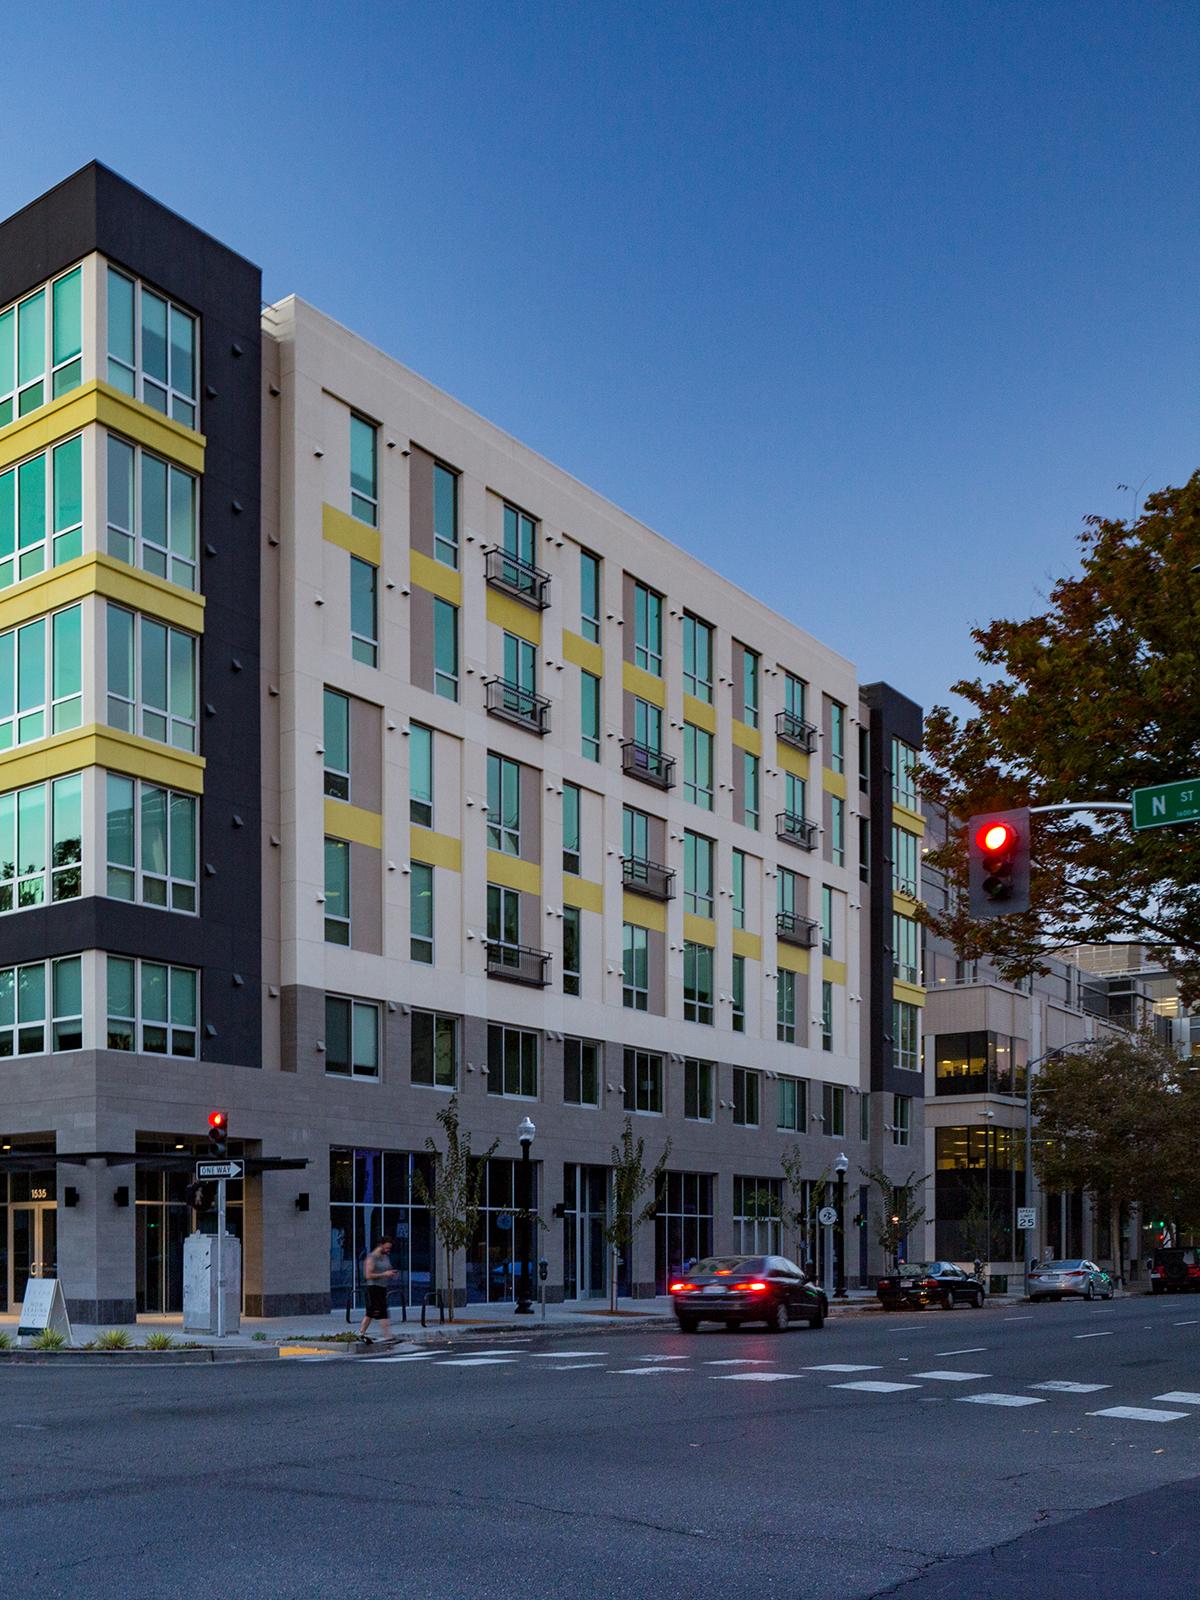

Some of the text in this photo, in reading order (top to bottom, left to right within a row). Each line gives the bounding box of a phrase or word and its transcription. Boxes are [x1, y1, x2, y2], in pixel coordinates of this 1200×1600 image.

[1152, 790, 1194, 817] N ST
[1019, 1218, 1035, 1227] 25
